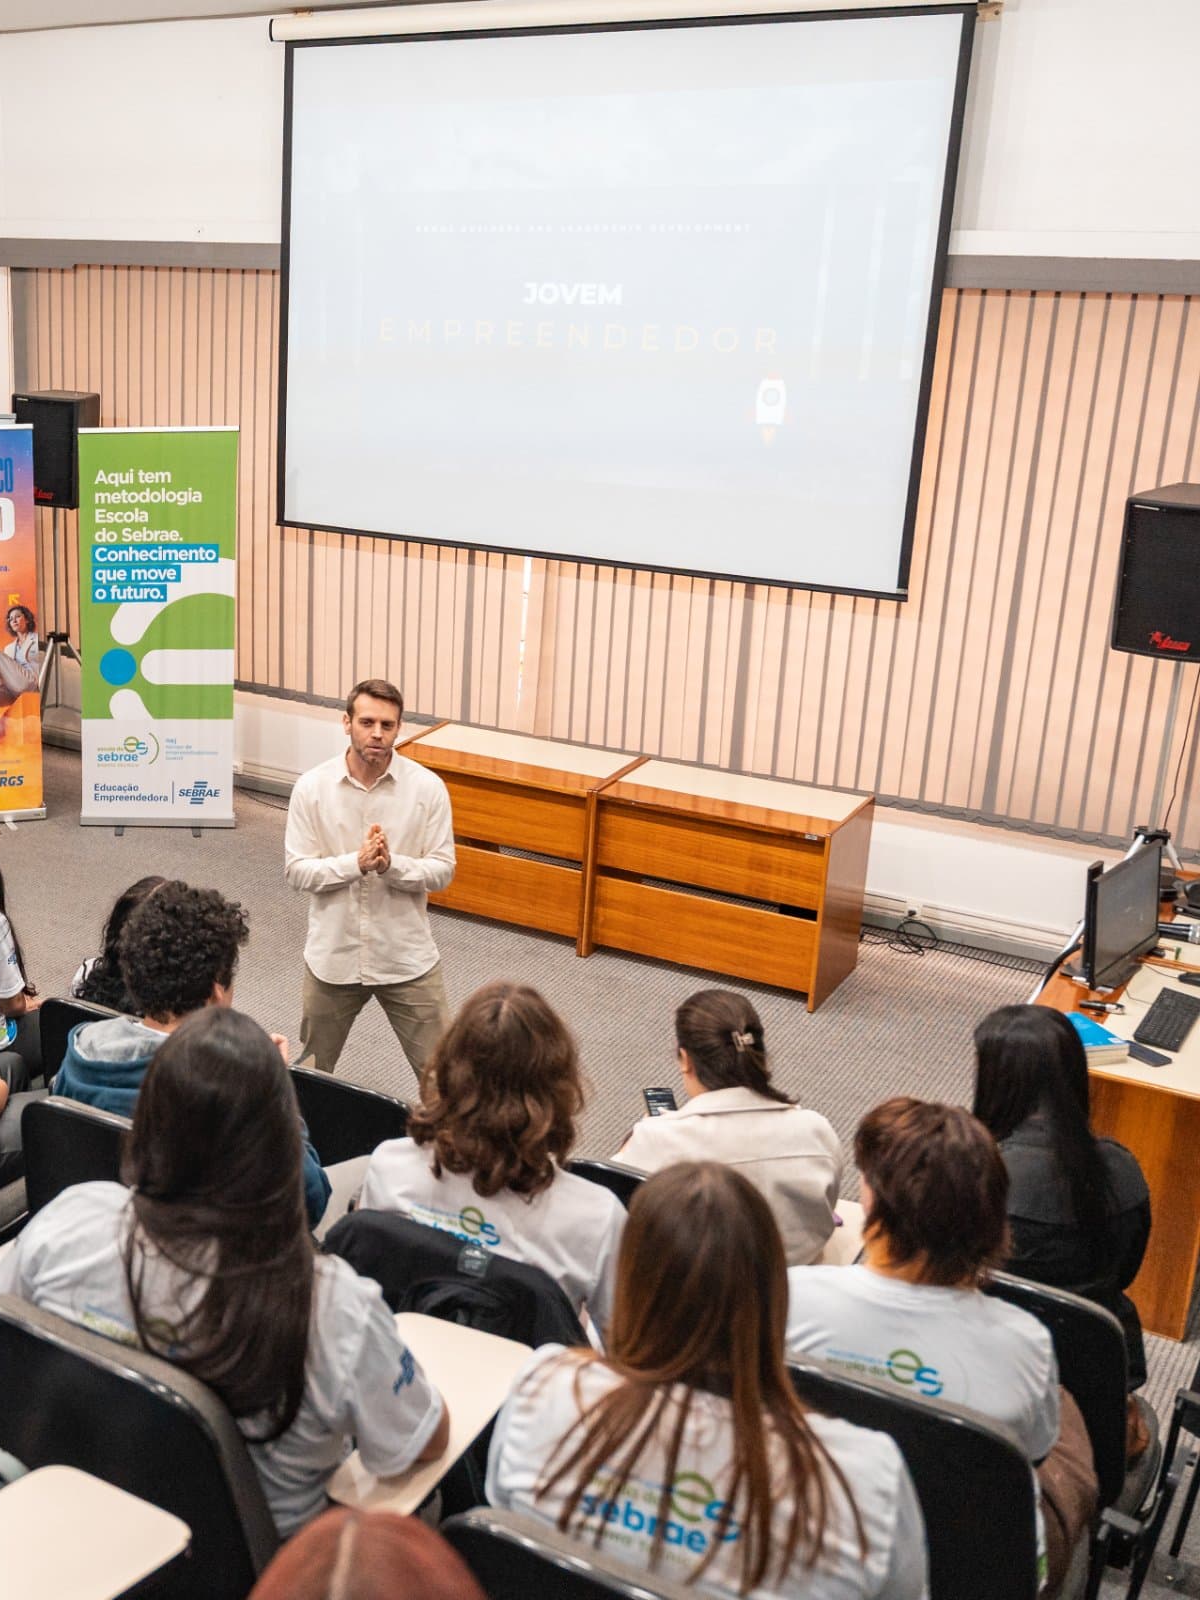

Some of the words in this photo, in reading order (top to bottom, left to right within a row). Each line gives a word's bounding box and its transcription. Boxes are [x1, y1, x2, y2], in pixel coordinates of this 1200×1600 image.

[522, 281, 623, 306] JOVEM
[379, 316, 778, 354] EMPREENDEDOR
[94, 468, 134, 487] Aqui
[138, 469, 172, 483] tem
[94, 487, 203, 505] metodologia
[94, 508, 149, 523] Escola
[94, 527, 118, 542] do
[122, 526, 184, 542] Sebrae.
[94, 546, 217, 562] Conhecimento
[94, 568, 128, 584] que
[131, 568, 177, 580] move
[94, 587, 107, 600] o
[110, 585, 164, 600] futuro.
[96, 751, 139, 762] sebrae
[94, 783, 139, 793] Educação
[178, 788, 221, 798] SEBRAE
[94, 793, 169, 803] Empreendedora
